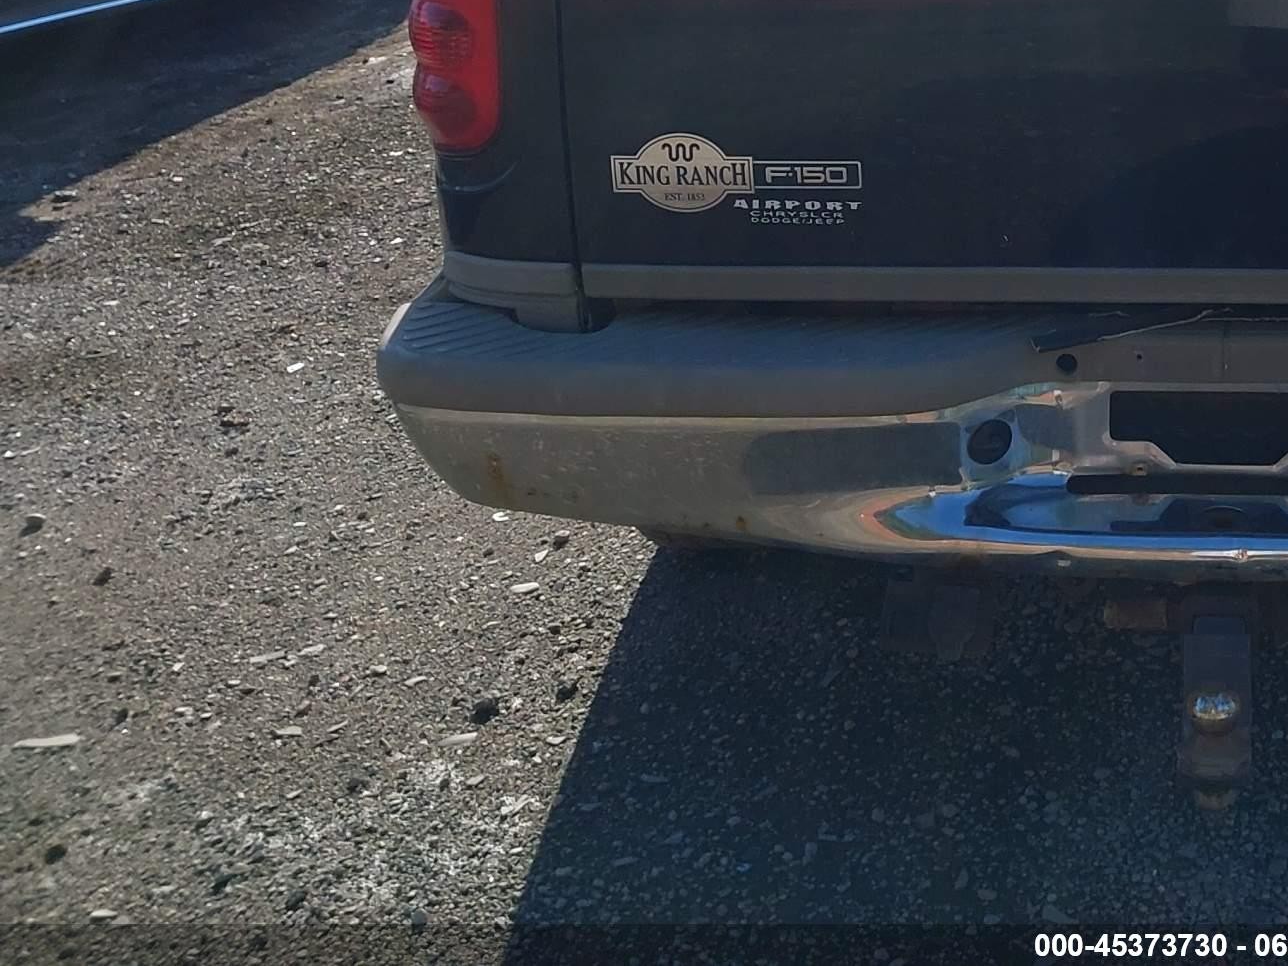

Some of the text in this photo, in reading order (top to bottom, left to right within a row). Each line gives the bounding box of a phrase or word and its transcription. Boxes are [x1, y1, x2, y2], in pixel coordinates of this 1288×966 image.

[618, 161, 748, 187] KING RANCH
[733, 198, 863, 211] AIRPORT
[749, 211, 844, 219] CHRYSLER
